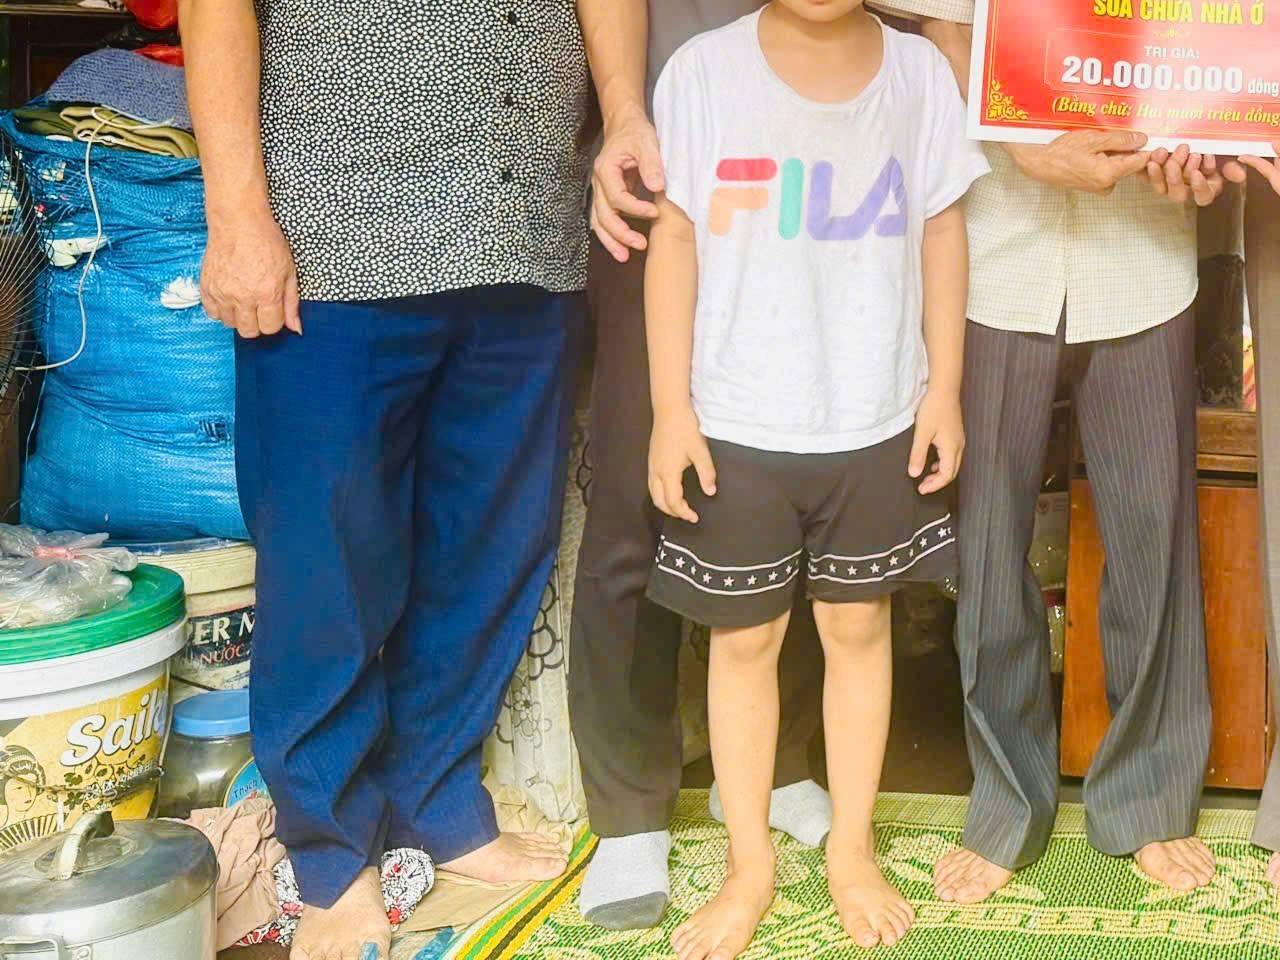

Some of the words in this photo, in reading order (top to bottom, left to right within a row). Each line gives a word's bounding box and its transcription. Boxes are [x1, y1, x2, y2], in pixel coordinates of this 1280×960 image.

[1202, 0, 1243, 25] NHÀ
[1061, 55, 1243, 94] 20.000.000
[1052, 95, 1097, 117] (Bằng
[1207, 107, 1241, 123] triệu
[708, 154, 908, 241] FILA
